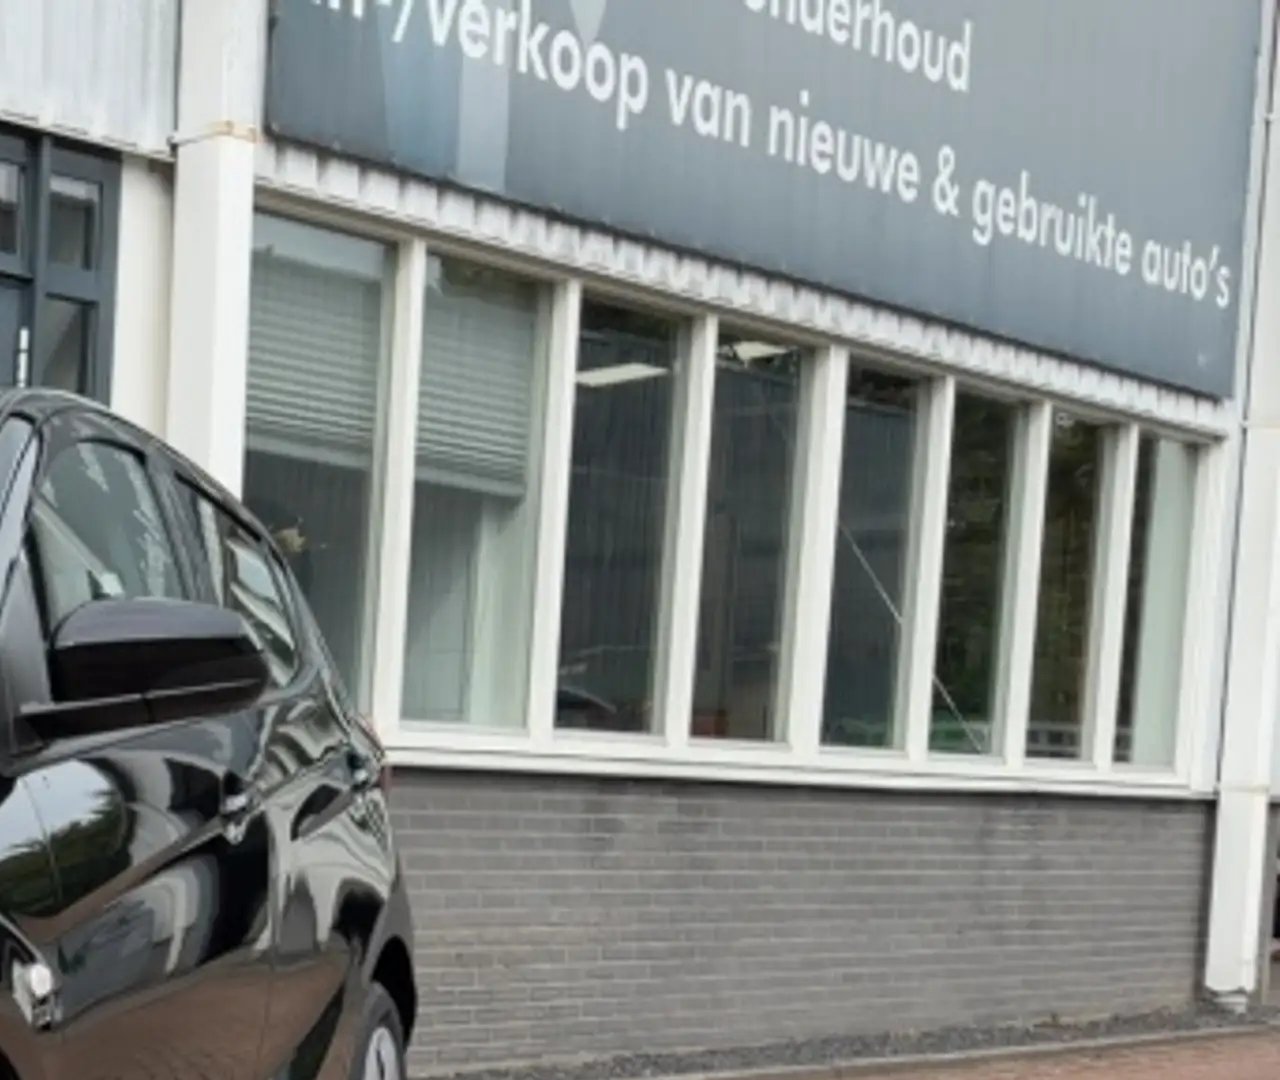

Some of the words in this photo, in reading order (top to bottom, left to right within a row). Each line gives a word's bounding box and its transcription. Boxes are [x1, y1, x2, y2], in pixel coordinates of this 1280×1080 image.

[665, 69, 751, 147] van
[768, 89, 920, 202] nieuwe
[932, 145, 960, 216] &
[972, 169, 1133, 275] gebruikte
